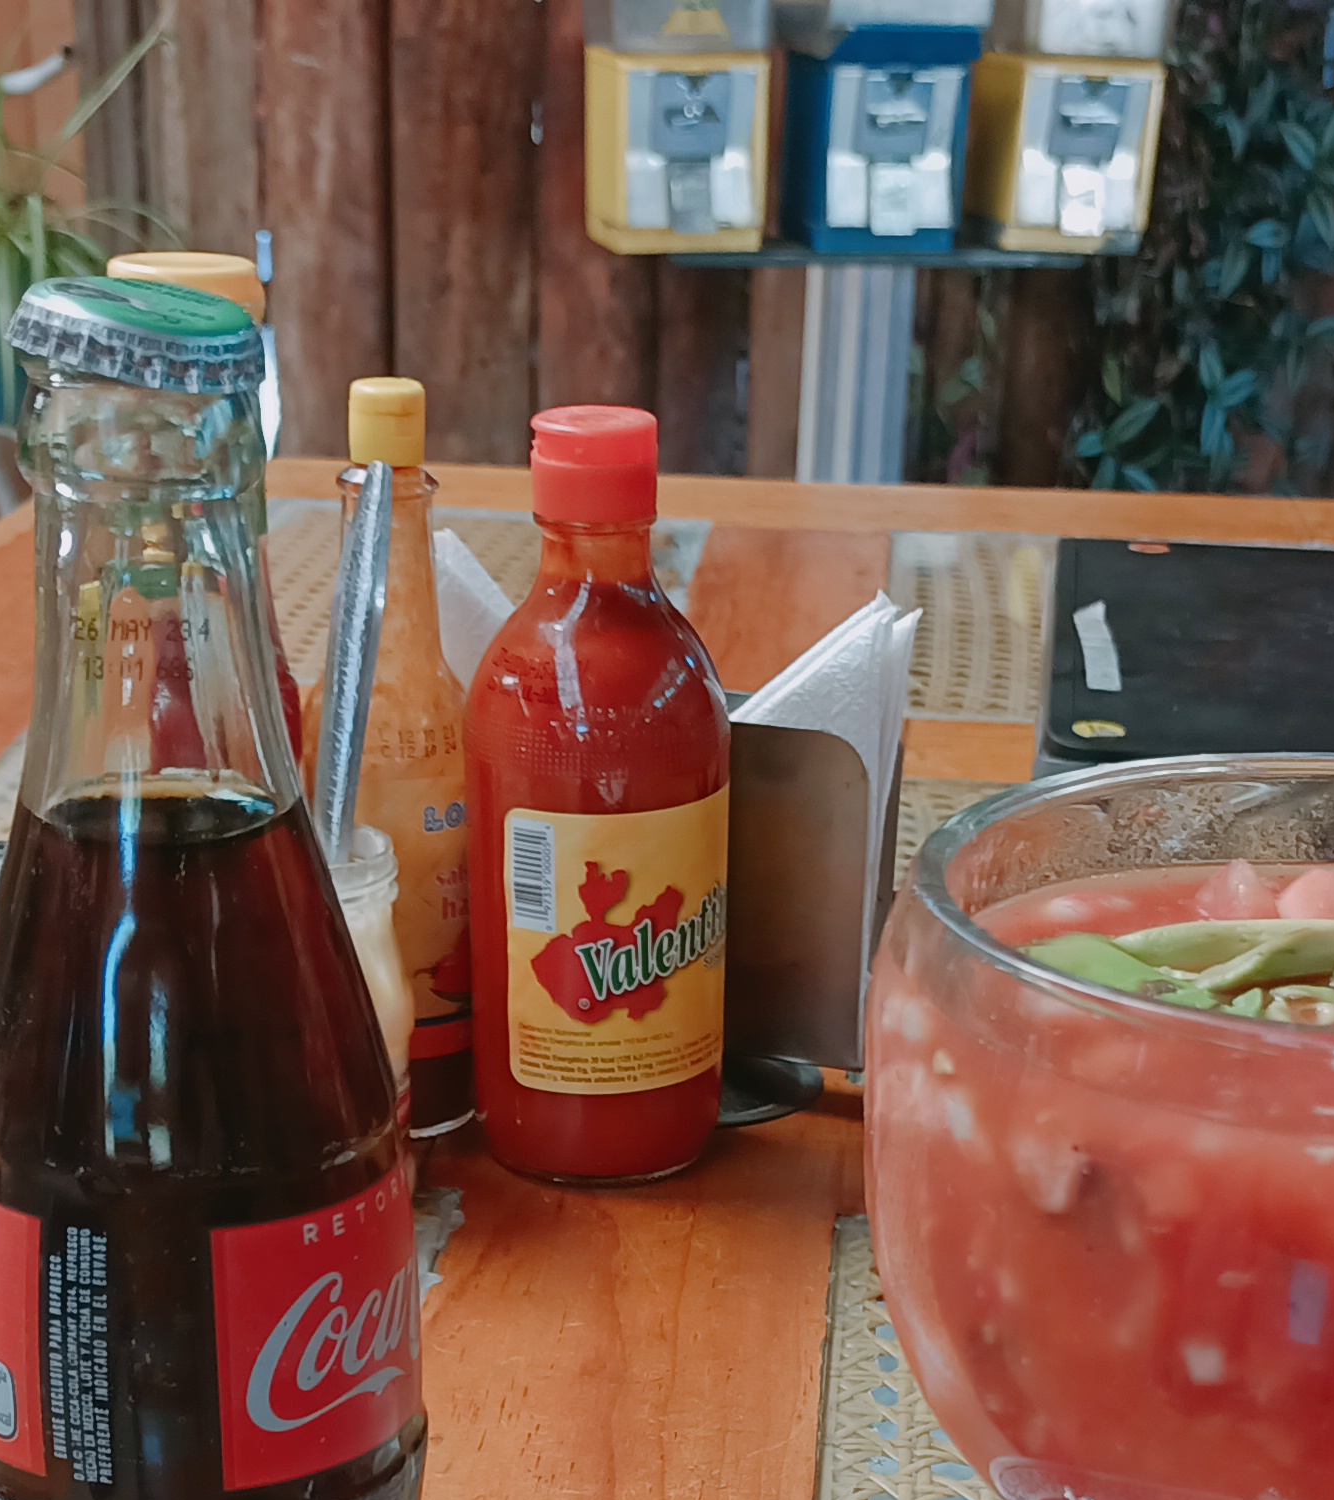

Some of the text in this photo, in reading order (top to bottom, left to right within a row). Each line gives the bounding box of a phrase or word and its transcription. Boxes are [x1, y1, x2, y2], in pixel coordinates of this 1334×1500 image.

[111, 617, 152, 641] MAY
[66, 1226, 78, 1282] REFRESCO
[79, 1228, 91, 1285] CONSUMO
[92, 1294, 108, 1309] EL
[92, 1315, 108, 1333] EN
[48, 1319, 62, 1350] PARA
[66, 1316, 79, 1367] COMPANY
[79, 1307, 91, 1344] FECHA
[49, 1352, 64, 1415] EXCLUSIVO
[79, 1359, 92, 1388] LOTE
[92, 1339, 109, 1402] INDICADO
[67, 1369, 80, 1426] COCA-COLA
[51, 1416, 68, 1460] ENVASE
[94, 1406, 113, 1485] PREFERENTE
